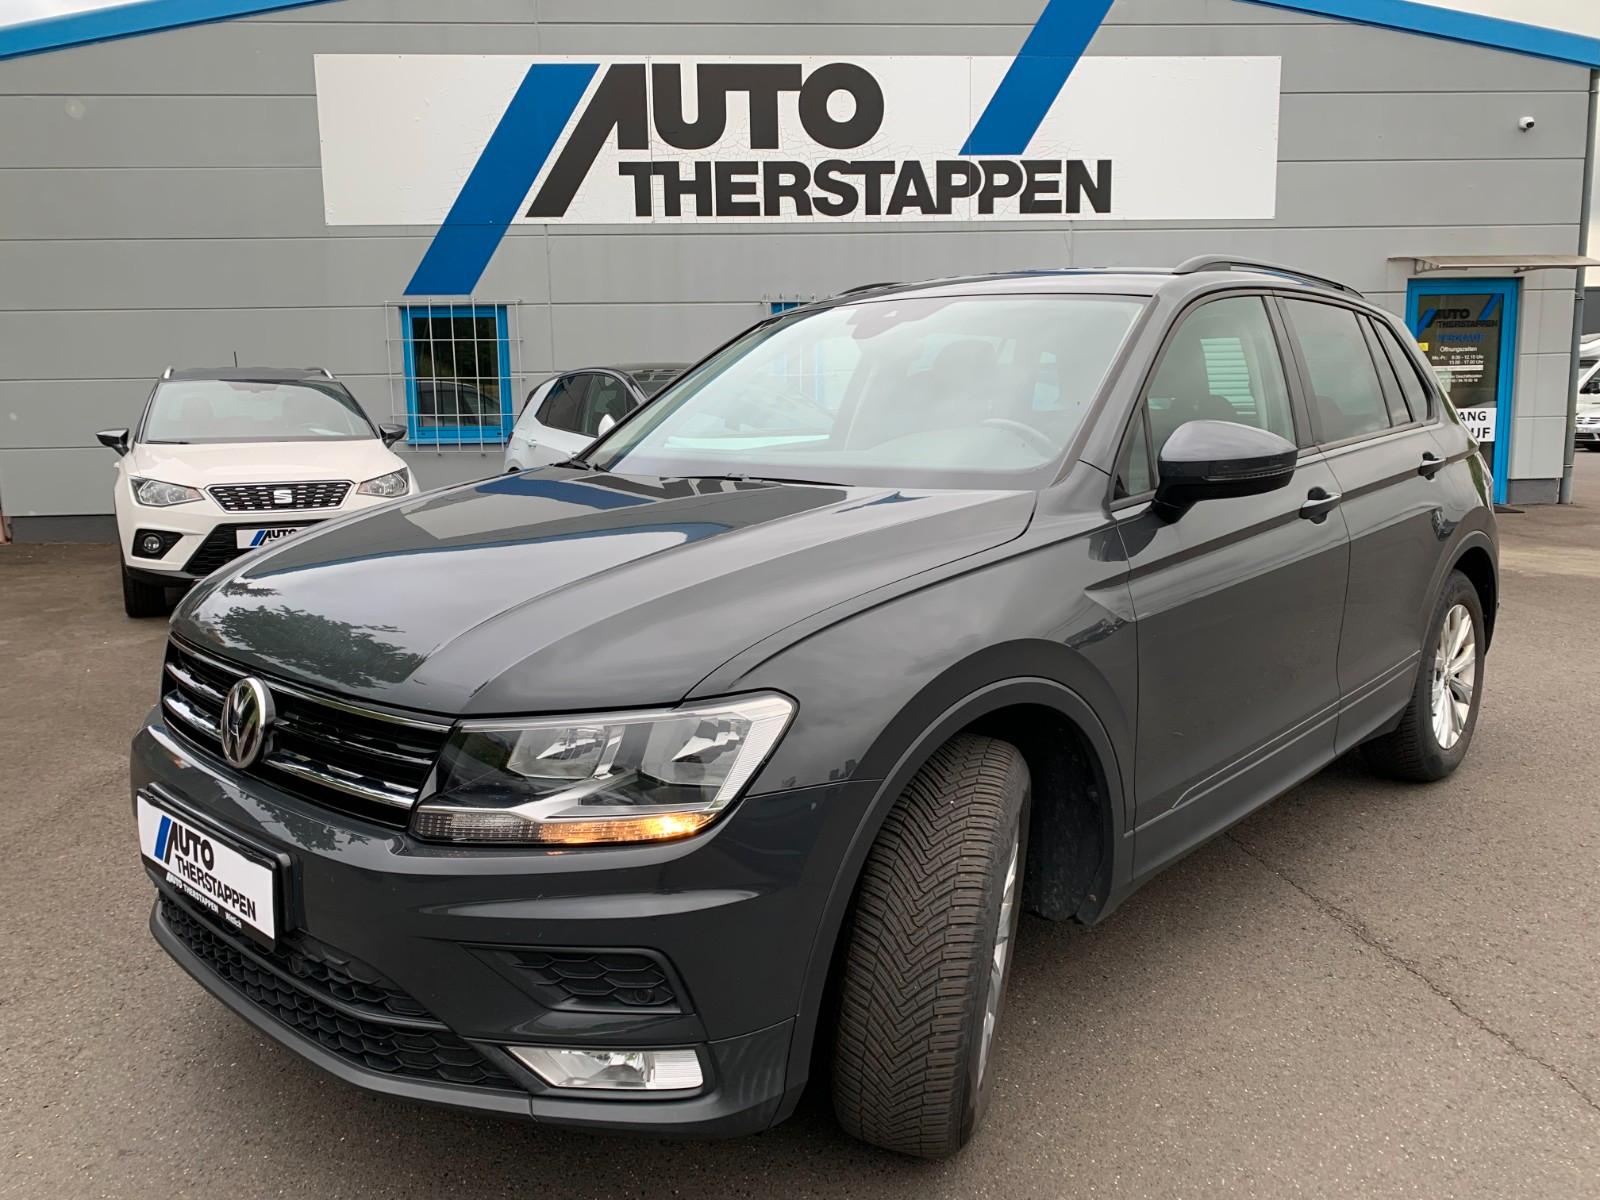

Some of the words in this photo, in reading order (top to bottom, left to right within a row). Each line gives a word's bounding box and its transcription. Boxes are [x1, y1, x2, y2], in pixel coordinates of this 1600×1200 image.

[525, 62, 884, 217] AUTO
[618, 159, 1112, 217] THERSTAPPEN
[1425, 308, 1470, 328] AUTO
[164, 821, 214, 871] AUTO
[175, 853, 257, 922] THERSTAPPEN
